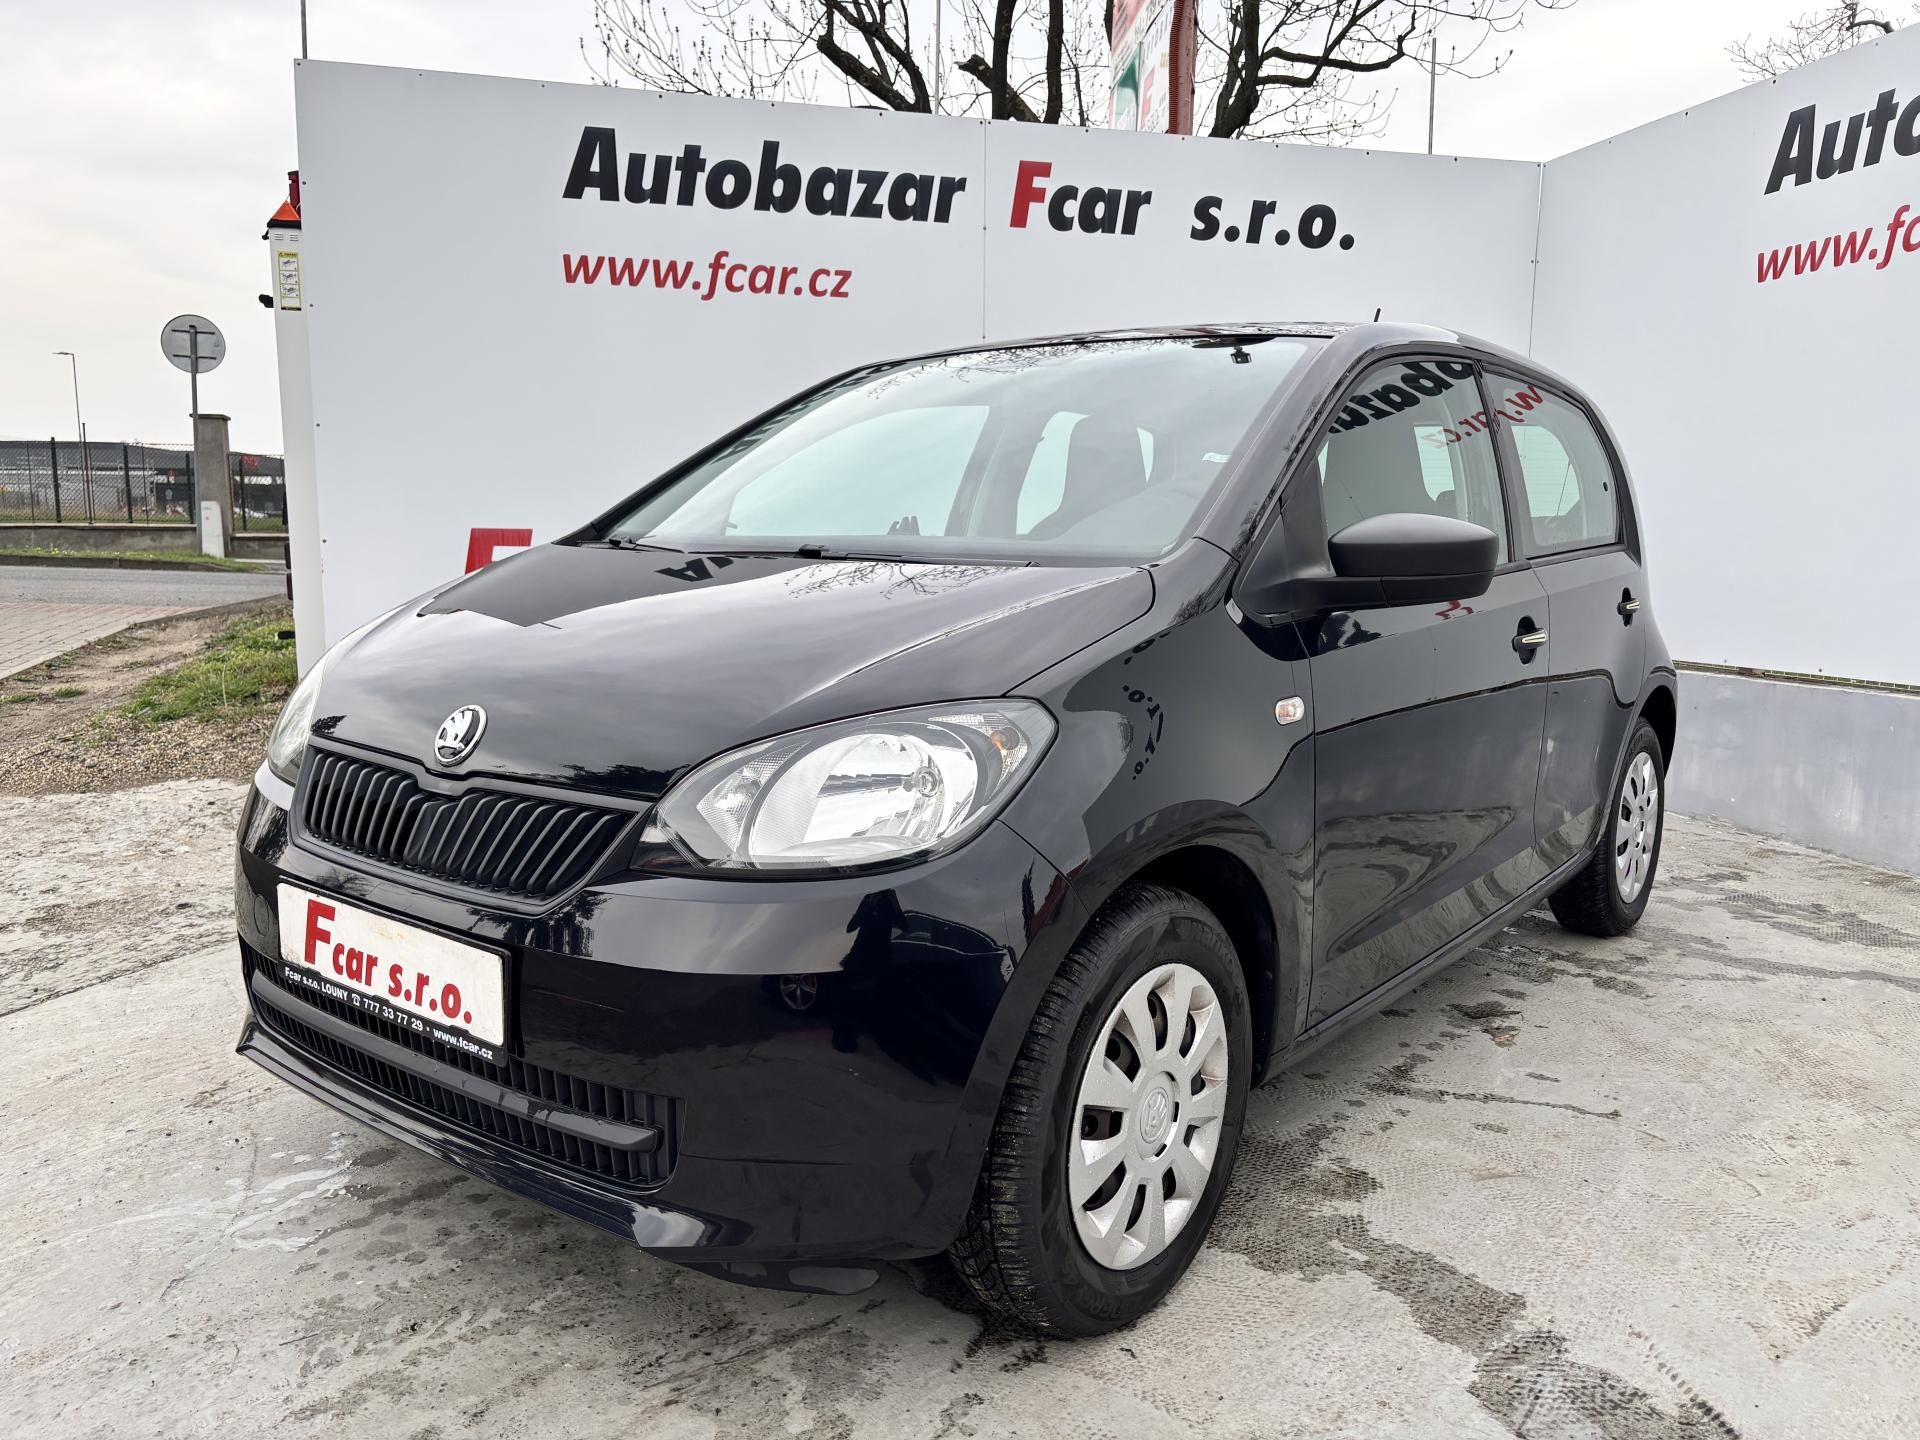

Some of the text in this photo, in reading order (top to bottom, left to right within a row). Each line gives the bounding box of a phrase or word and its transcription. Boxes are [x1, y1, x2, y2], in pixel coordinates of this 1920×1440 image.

[562, 125, 1356, 251] Autobazar Fcar s.r.o.
[563, 250, 852, 301] www.fcar.cz
[284, 966, 494, 1060] Fcar s.r.o. LOUNY 777 33 77 29 www.fcar.cz
[304, 898, 472, 1025] Fcar s.r.o.
